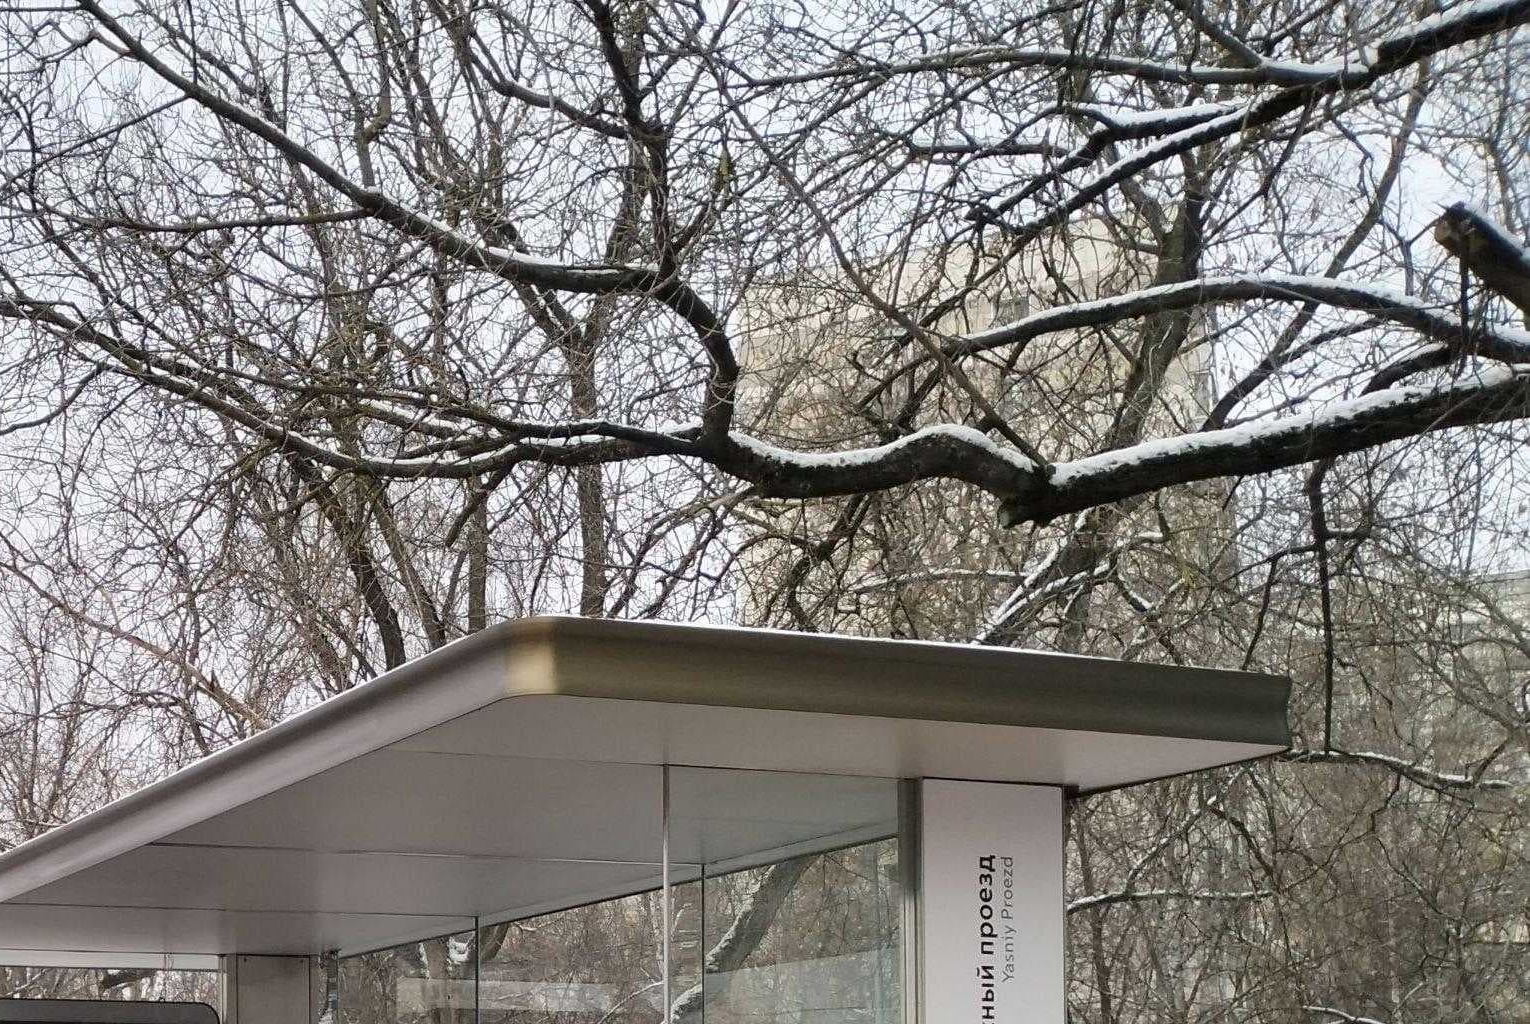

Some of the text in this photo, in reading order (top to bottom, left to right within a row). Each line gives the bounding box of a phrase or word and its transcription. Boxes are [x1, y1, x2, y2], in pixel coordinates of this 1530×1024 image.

[979, 855, 998, 955] проезд
[1001, 856, 1017, 983] Yasniy Proezd
